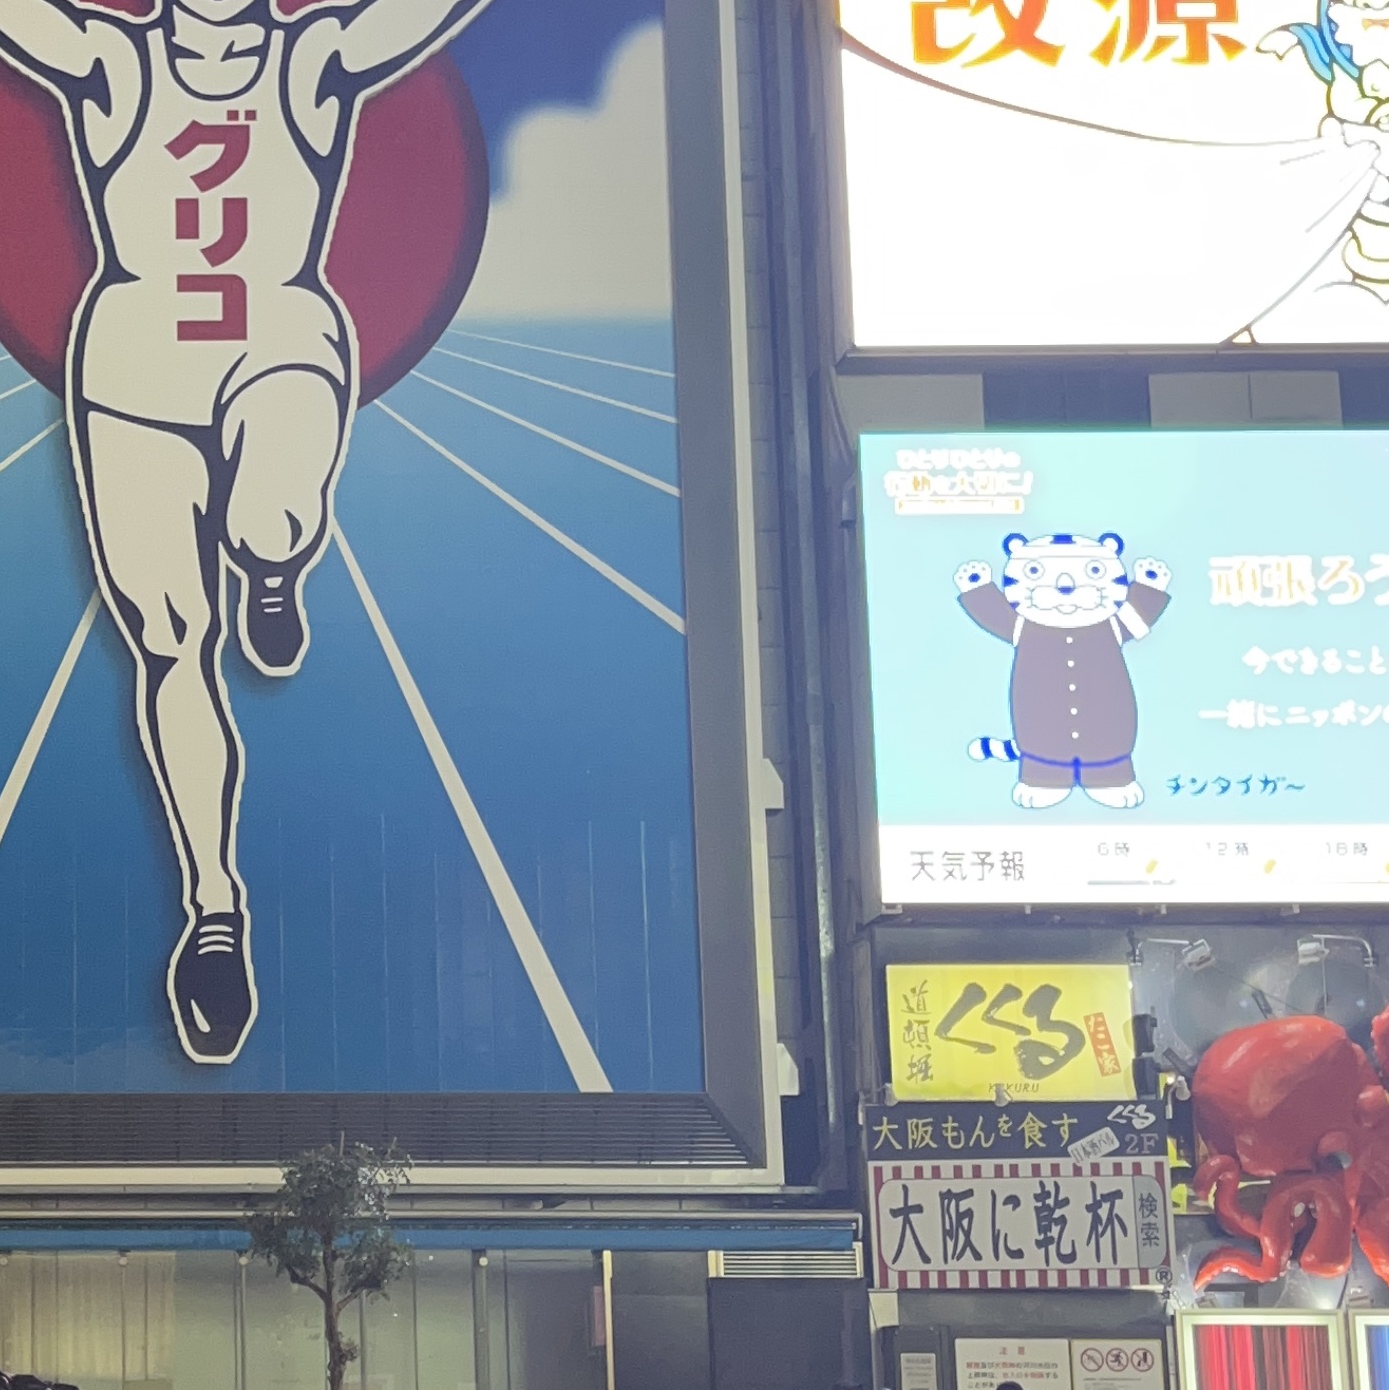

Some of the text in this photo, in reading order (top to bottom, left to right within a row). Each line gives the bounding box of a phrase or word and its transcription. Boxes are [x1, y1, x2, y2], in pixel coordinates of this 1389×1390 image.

[164, 109, 257, 341] グリコ
[910, 850, 1025, 881] 天気予報
[901, 980, 933, 1084] 道頓堀
[935, 982, 1086, 1080] くくる
[988, 1082, 1040, 1093] KKURU
[873, 1112, 1079, 1150] 大阪もんを食す
[1107, 1104, 1156, 1129] くくる
[1124, 1133, 1159, 1154] 2F
[890, 1182, 1161, 1267] 大阪に乾杯 検索
